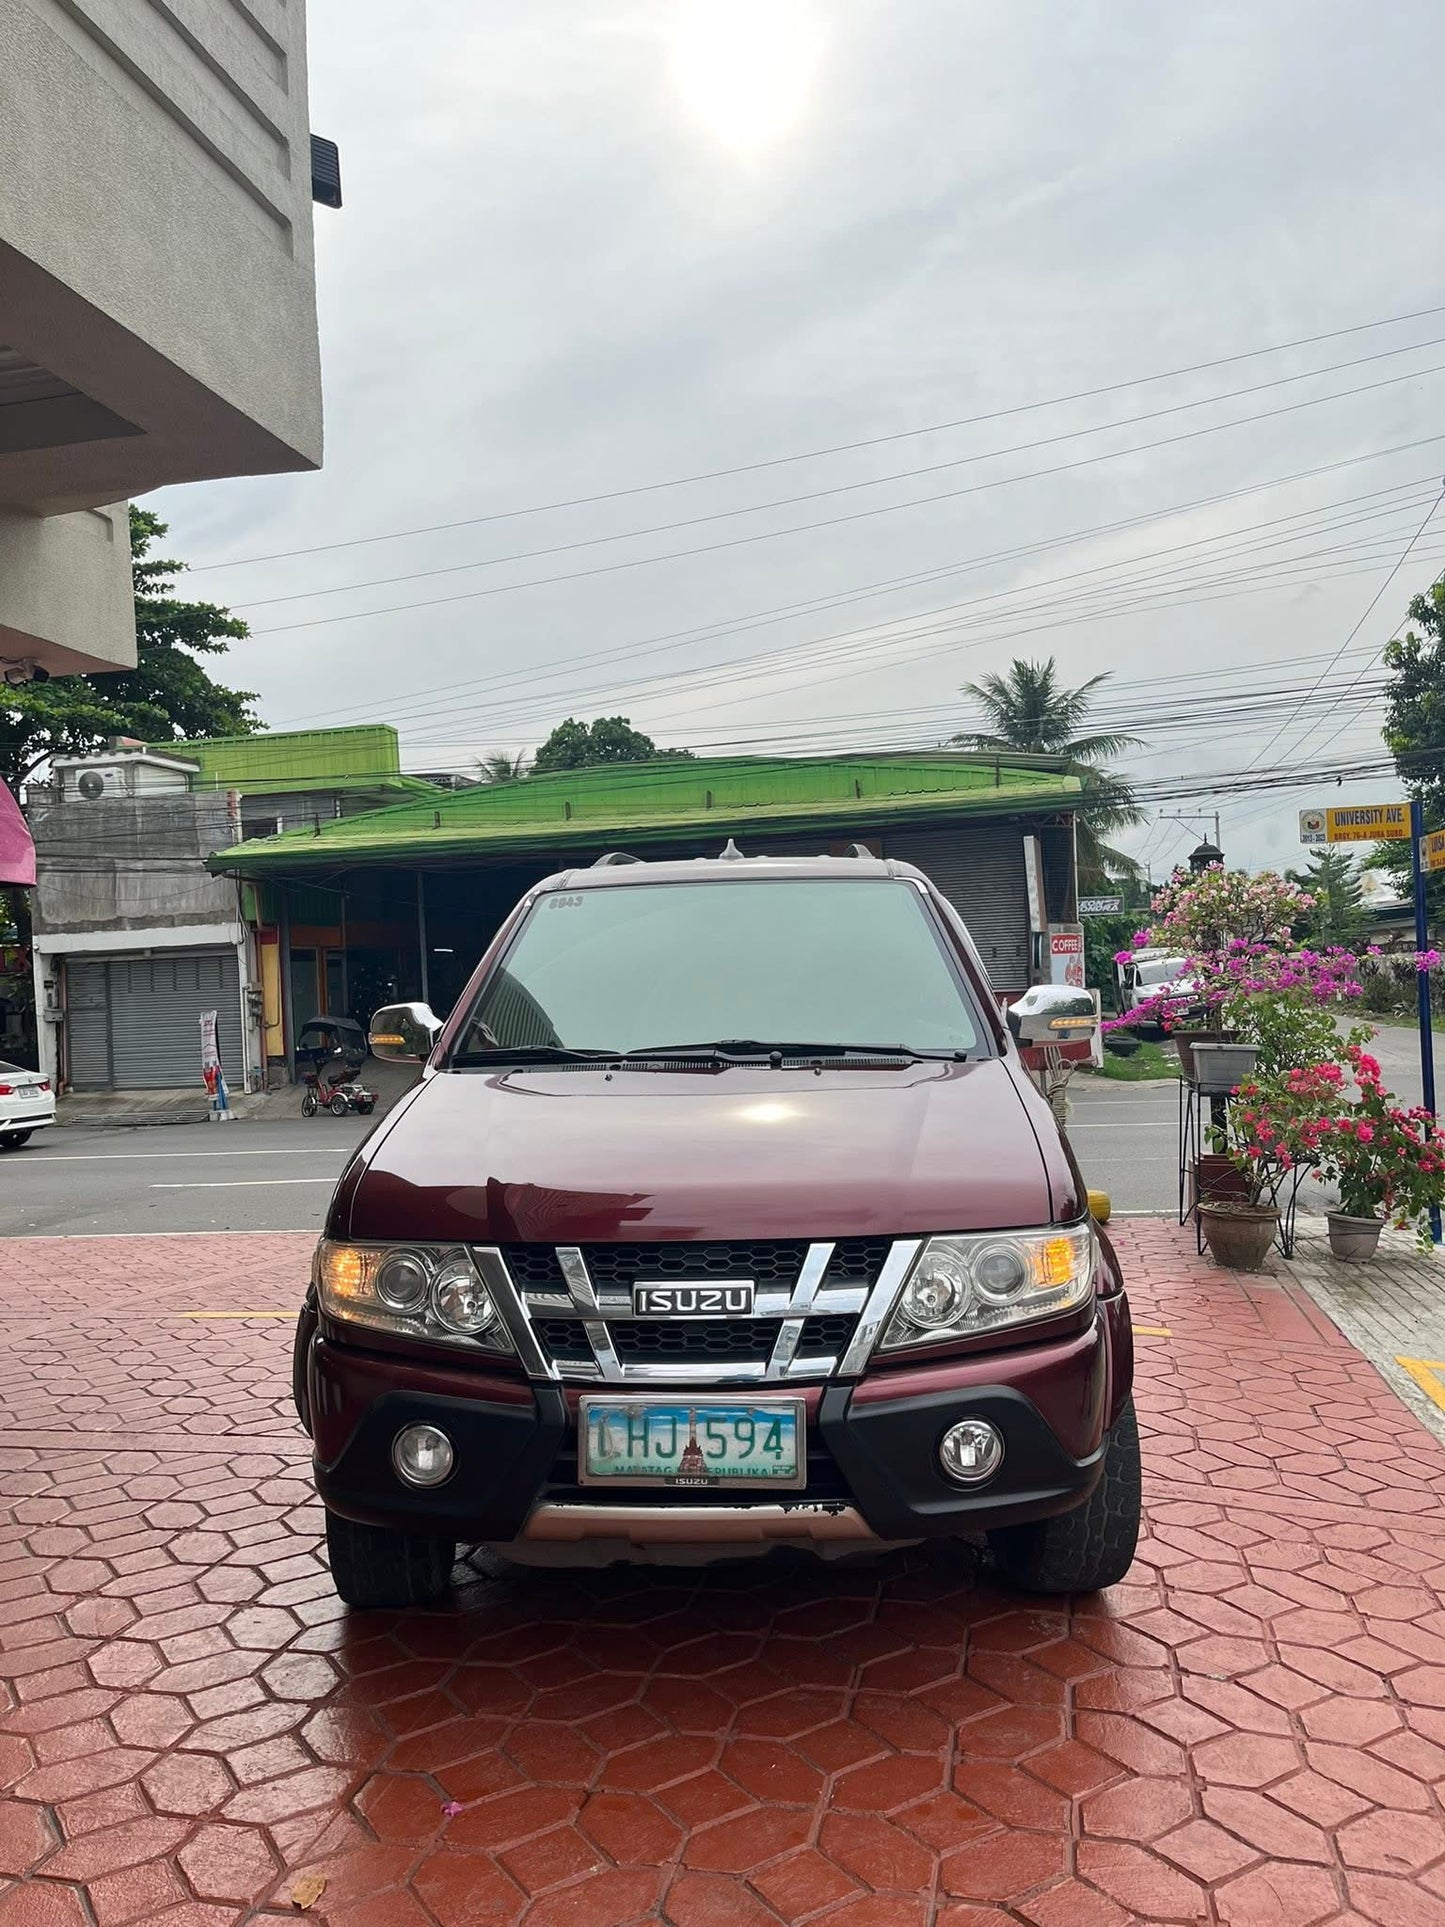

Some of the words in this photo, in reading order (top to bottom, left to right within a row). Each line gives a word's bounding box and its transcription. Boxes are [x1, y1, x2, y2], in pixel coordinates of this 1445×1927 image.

[1335, 809, 1383, 827] UNIVERSITY
[1386, 807, 1405, 823] AVE.
[1052, 939, 1078, 951] COFFEE
[640, 1290, 747, 1312] ISUZU
[706, 1416, 785, 1460] 594
